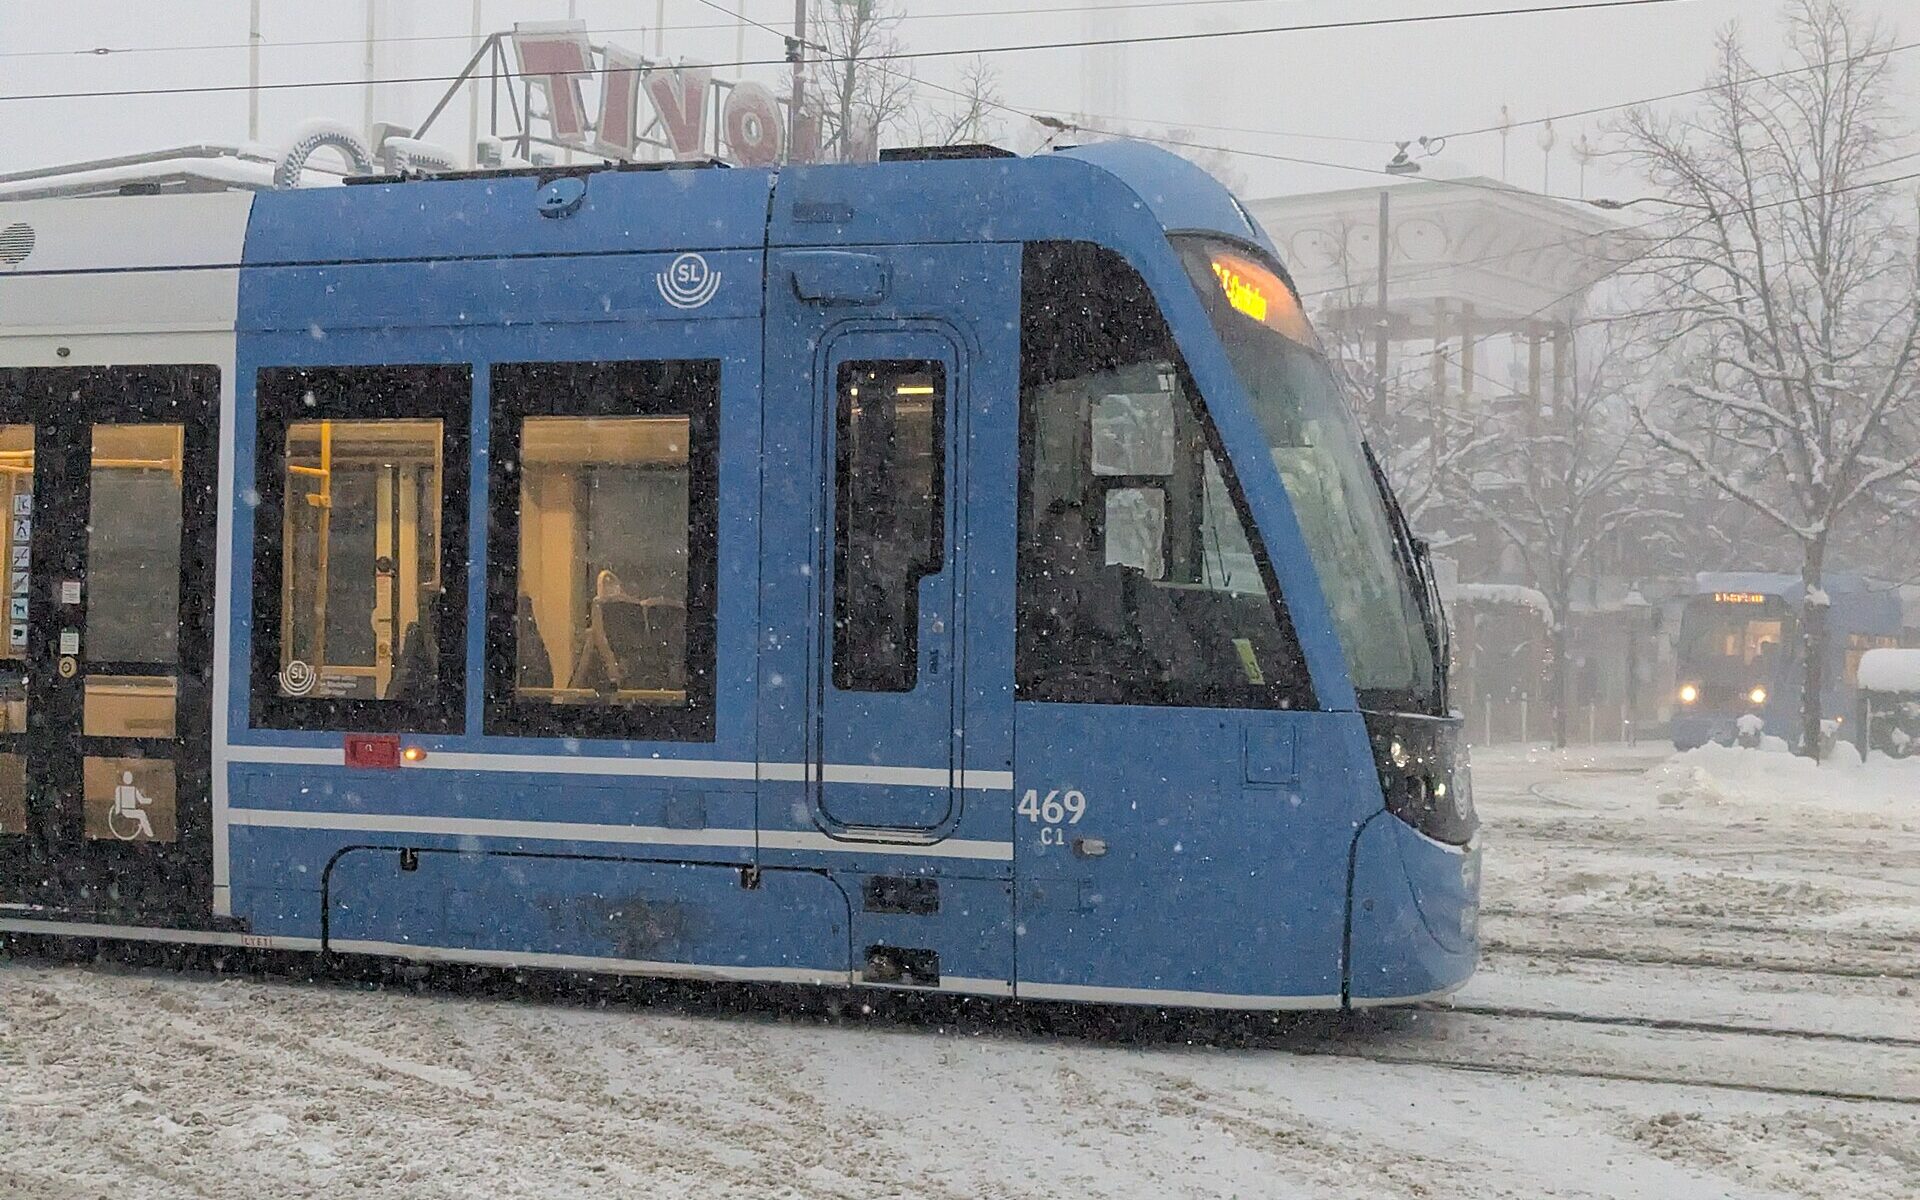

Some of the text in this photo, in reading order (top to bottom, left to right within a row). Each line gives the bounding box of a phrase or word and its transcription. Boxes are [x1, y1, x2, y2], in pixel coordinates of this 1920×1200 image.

[677, 264, 700, 282] SL
[291, 667, 304, 679] SL
[1017, 789, 1087, 824] 469
[1040, 827, 1065, 845] C1
